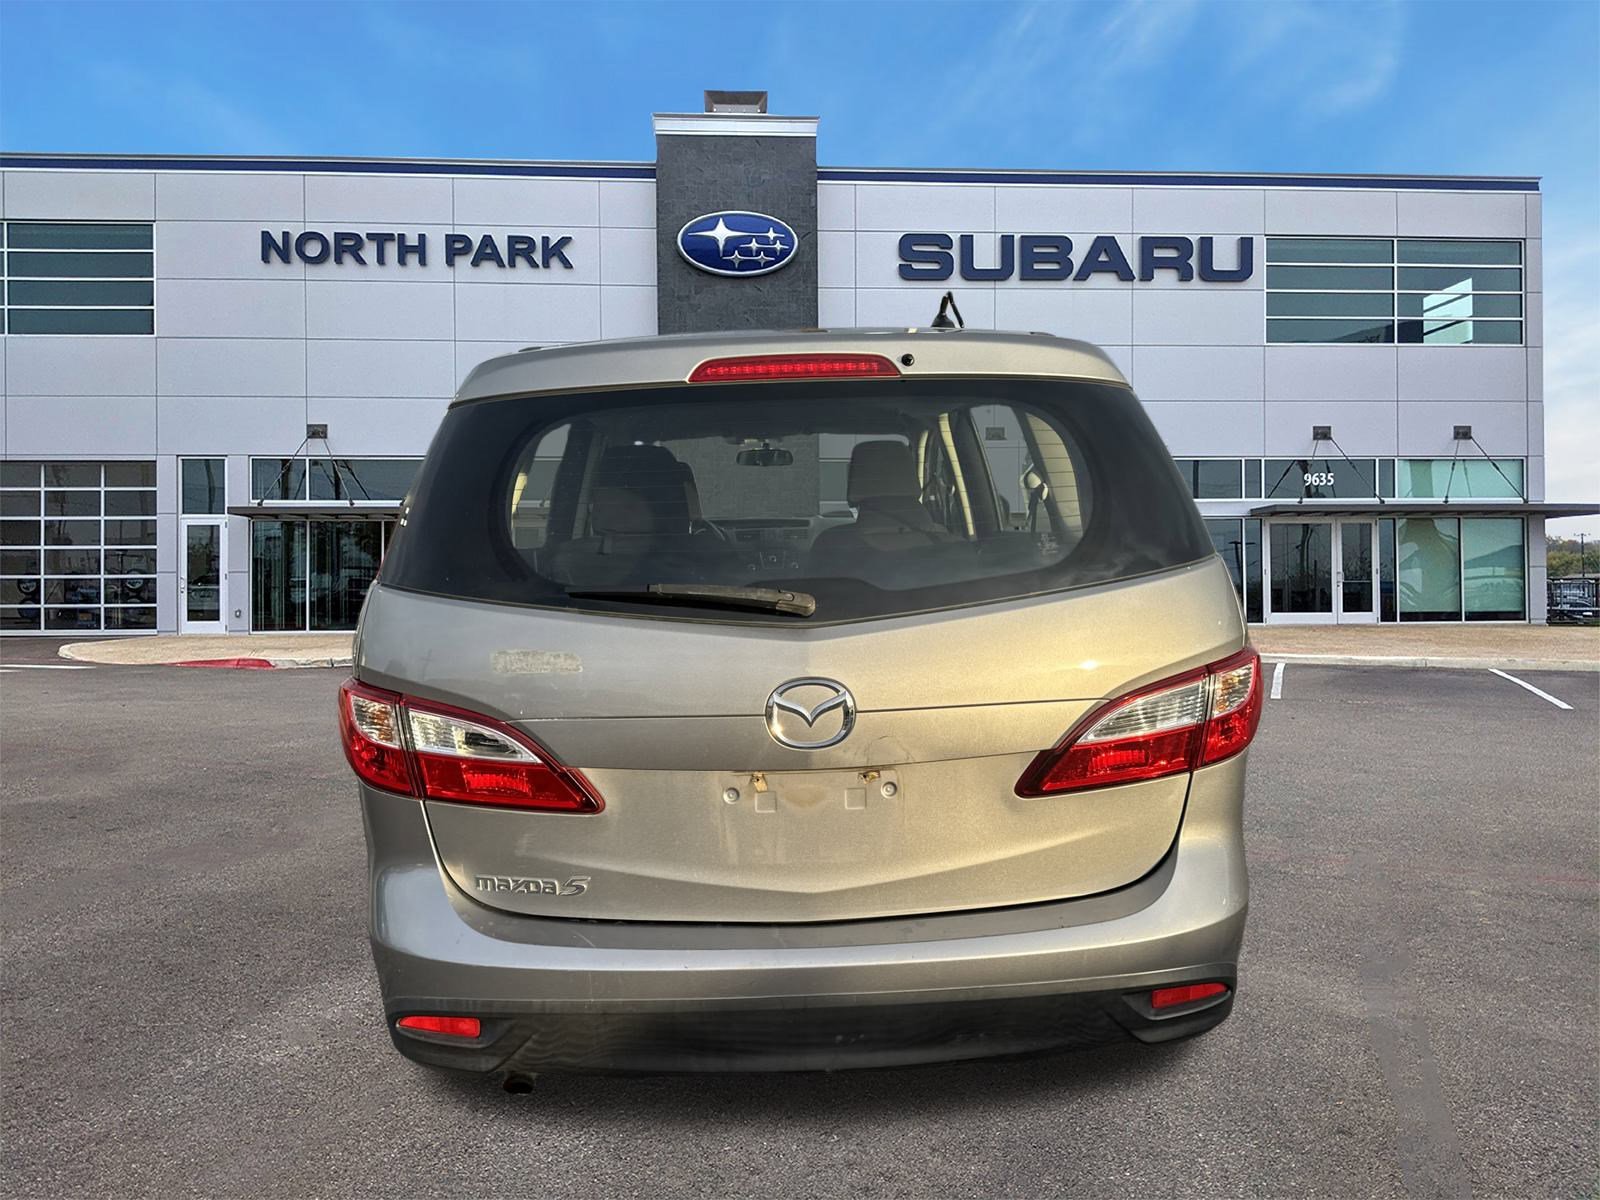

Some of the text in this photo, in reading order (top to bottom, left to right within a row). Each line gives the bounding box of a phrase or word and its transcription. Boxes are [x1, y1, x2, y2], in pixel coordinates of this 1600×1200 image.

[260, 230, 574, 269] NORTH PARK
[898, 233, 1254, 282] SUBARU
[1303, 472, 1335, 486] 9635
